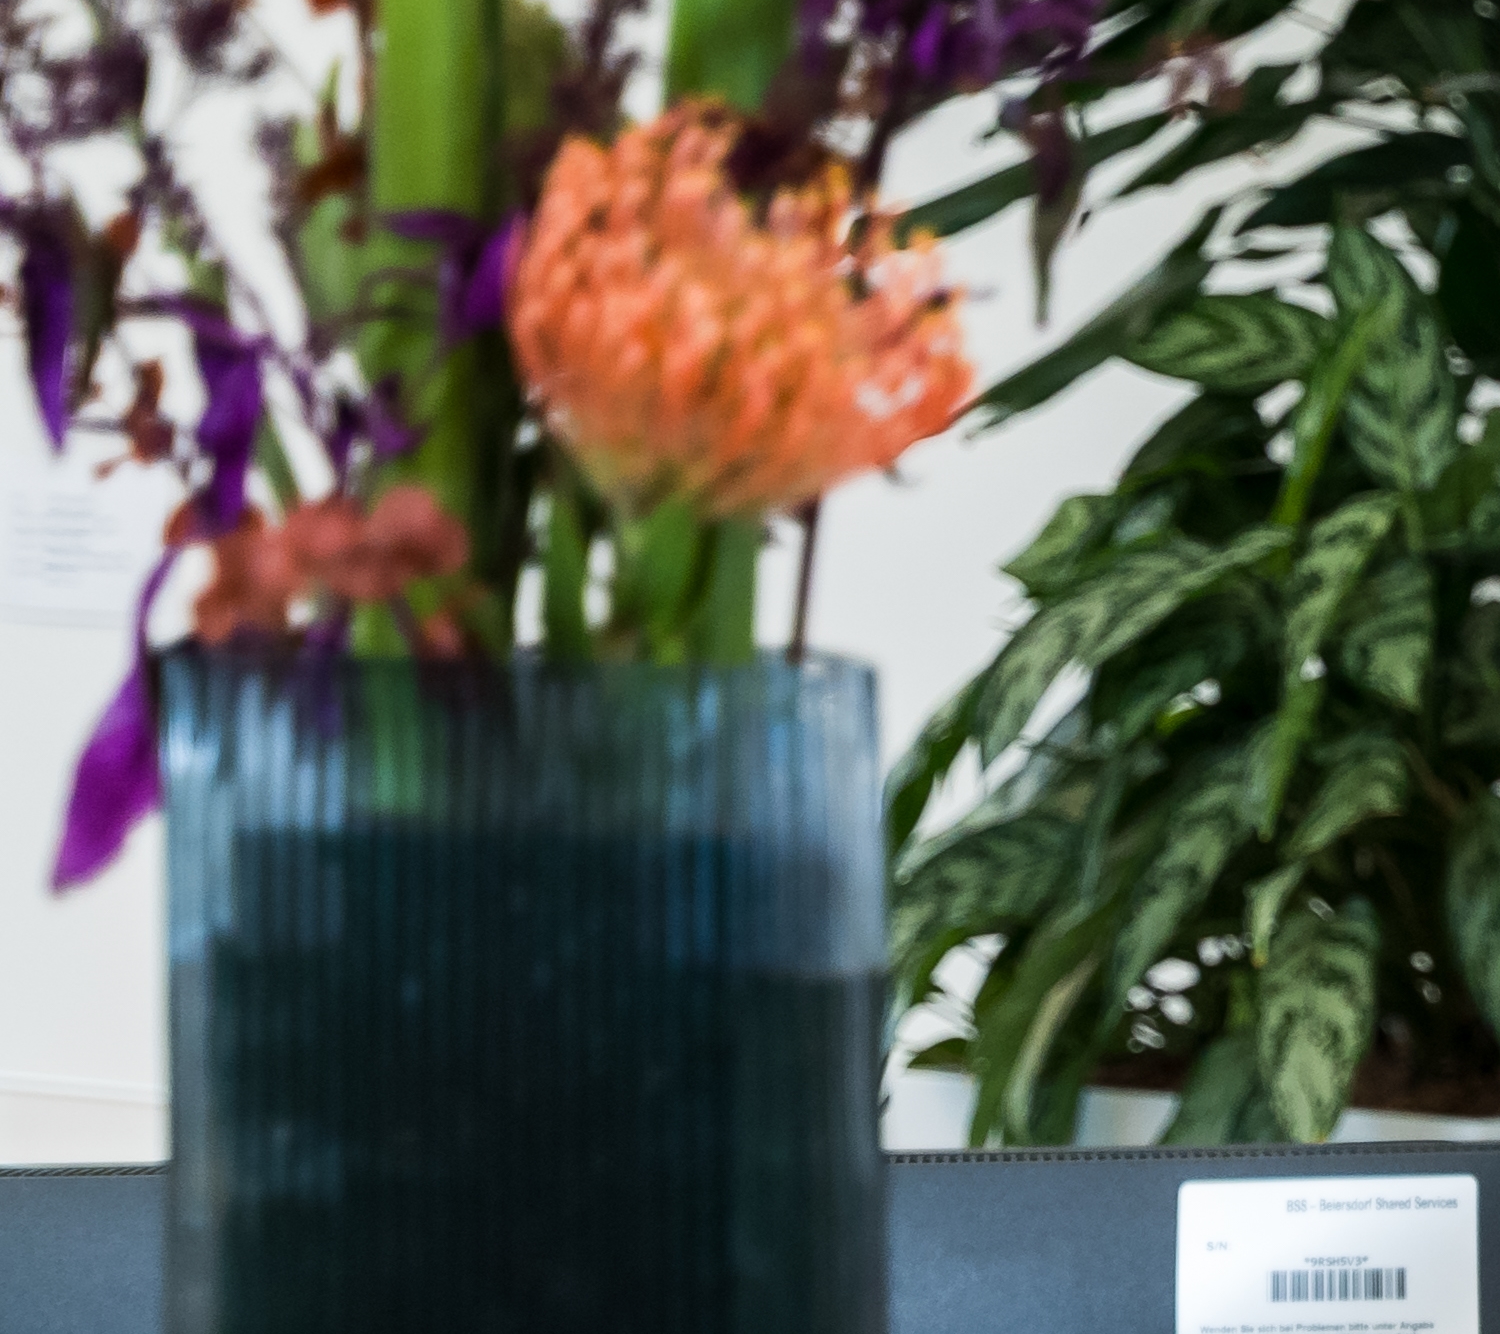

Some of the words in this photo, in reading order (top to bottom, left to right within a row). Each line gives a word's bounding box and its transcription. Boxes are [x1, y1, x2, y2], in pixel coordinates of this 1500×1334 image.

[1286, 1199, 1307, 1213] BSS
[1319, 1198, 1372, 1212] Beiersdorf
[1375, 1197, 1411, 1210] Shared
[1414, 1196, 1458, 1210] Services
[1200, 1326, 1237, 1334] Wenden
[1241, 1325, 1254, 1333] Sie
[1258, 1325, 1277, 1333] sich
[1279, 1324, 1293, 1332] bei
[1296, 1323, 1345, 1332] Problemen
[1349, 1323, 1369, 1331] bitte
[1372, 1323, 1396, 1331] unter
[1400, 1322, 1434, 1332] Angabe
